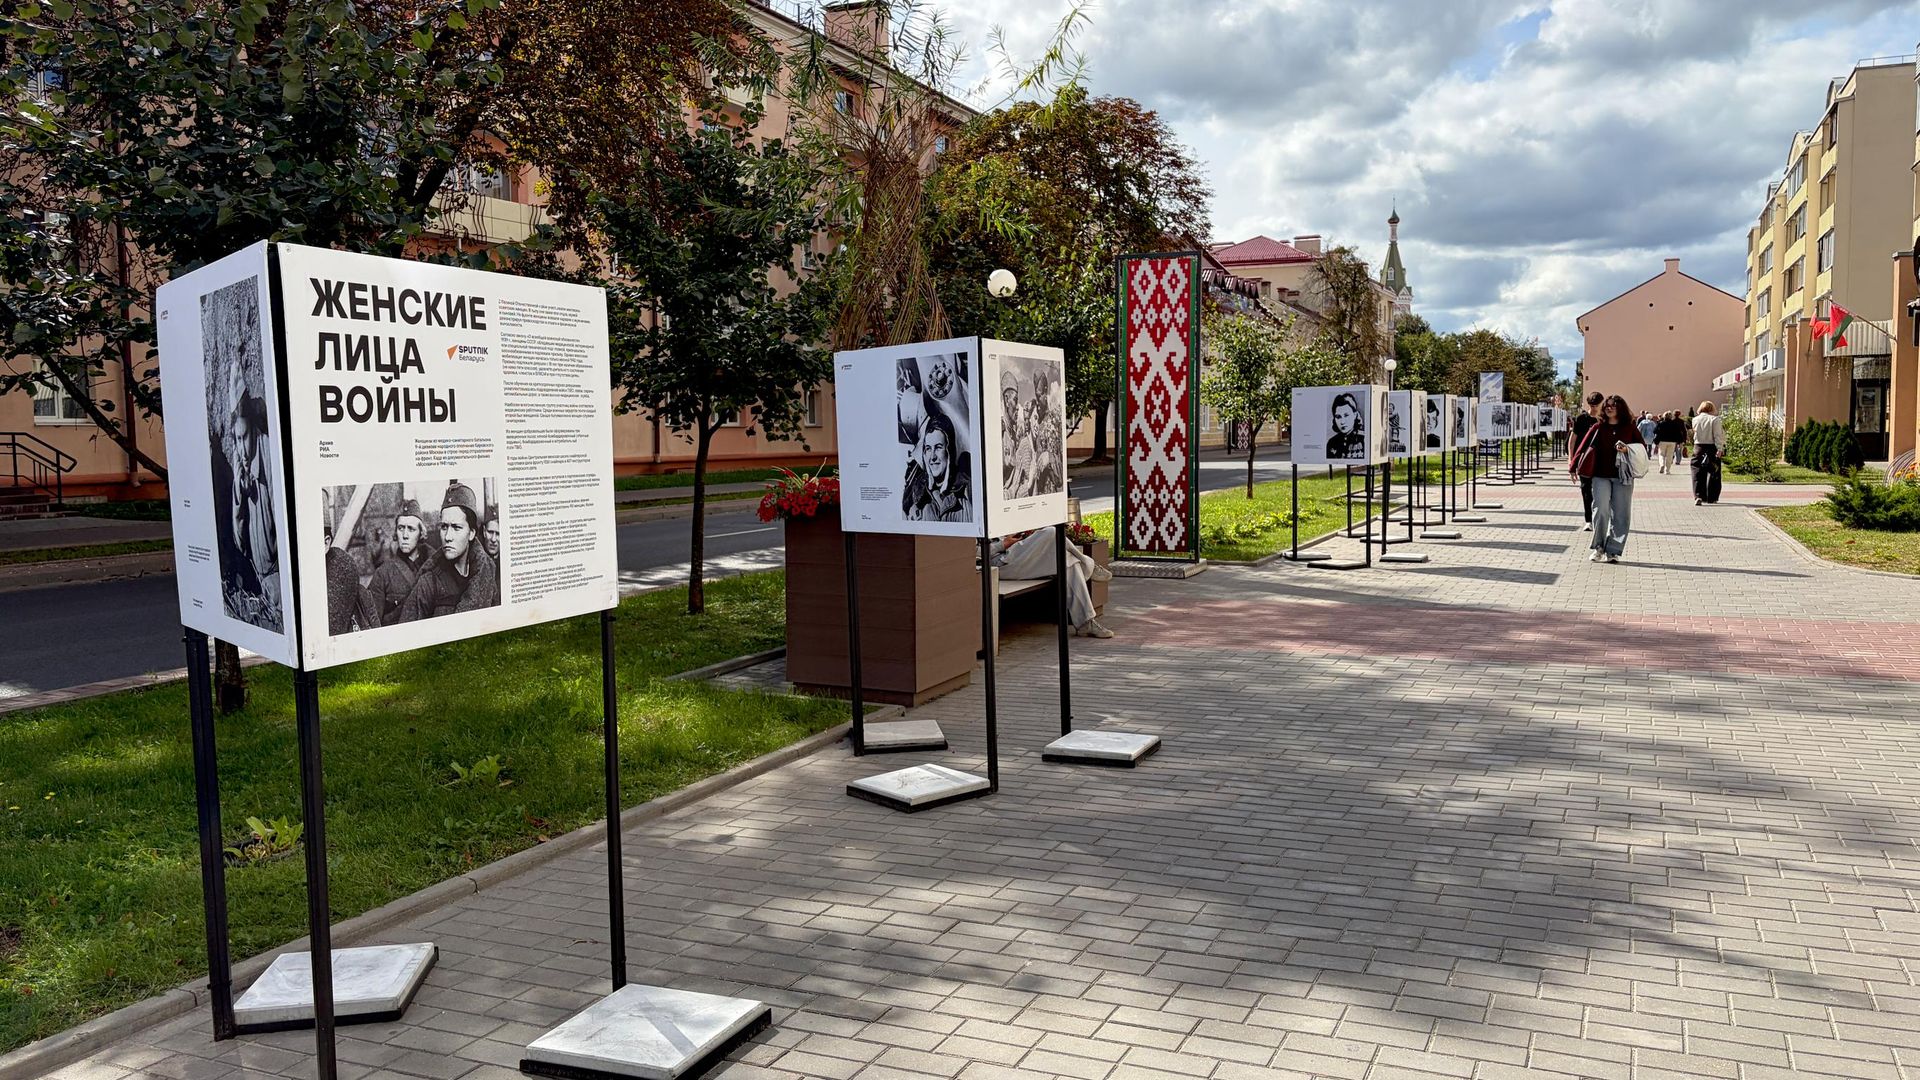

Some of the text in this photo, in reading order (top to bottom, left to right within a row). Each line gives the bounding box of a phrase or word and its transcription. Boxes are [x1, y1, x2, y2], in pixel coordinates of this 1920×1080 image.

[309, 277, 487, 331] ЖЕНСКИЕ
[314, 332, 425, 380] ЛИЦА
[458, 354, 486, 363] Беларусь
[319, 375, 457, 424] ВОЙНЫ
